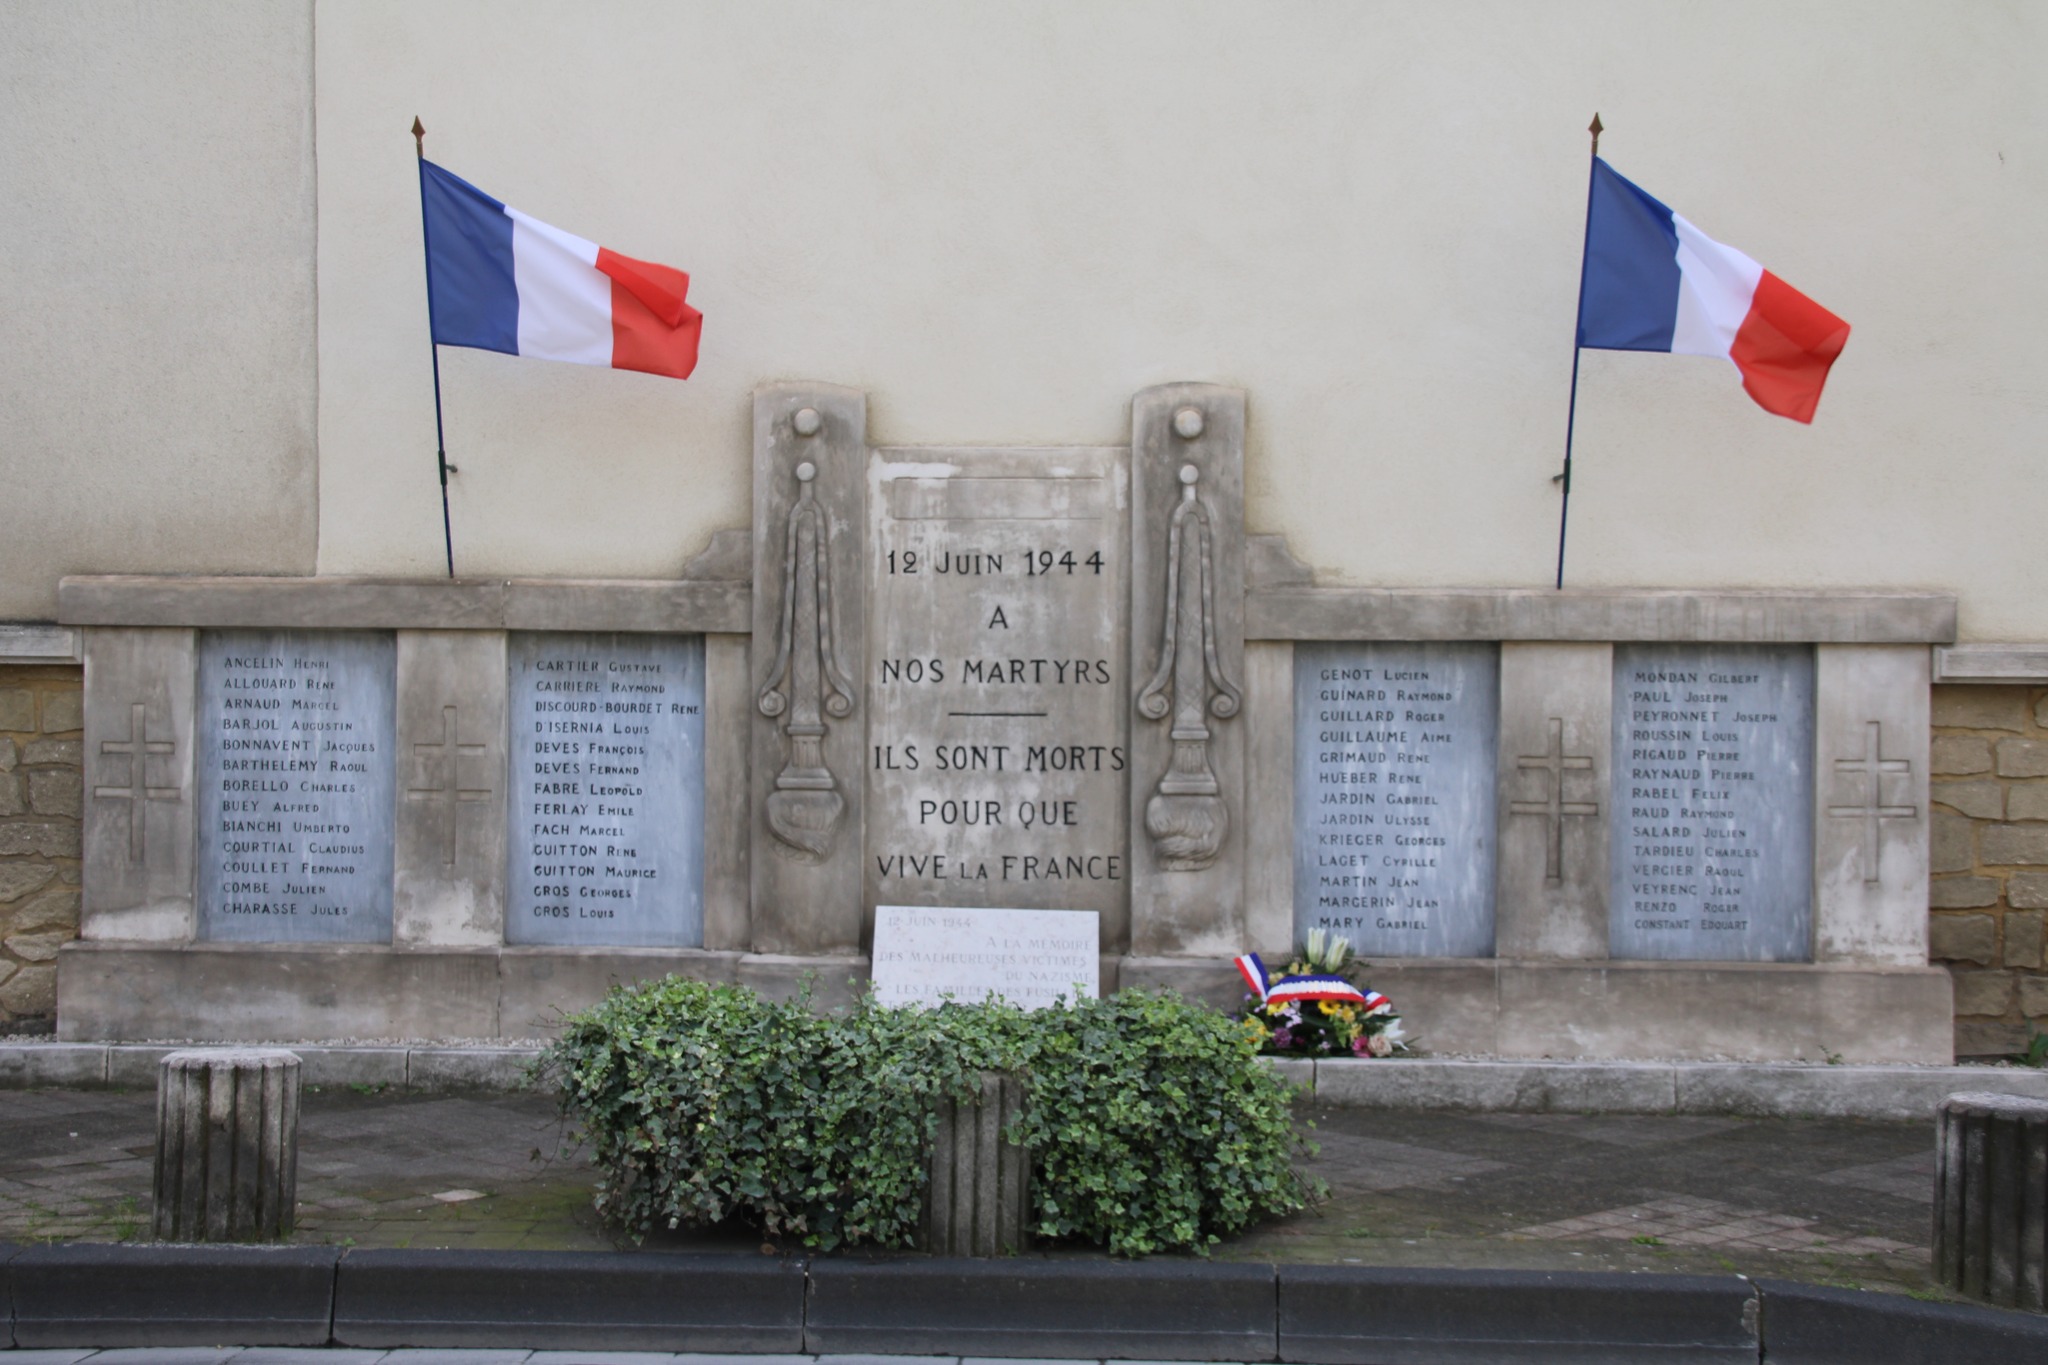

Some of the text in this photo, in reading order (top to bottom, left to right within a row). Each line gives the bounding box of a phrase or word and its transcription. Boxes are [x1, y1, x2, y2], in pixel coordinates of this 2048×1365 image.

[887, 550, 1105, 576] 12 JUIN 1944
[988, 605, 1009, 629] A
[224, 657, 329, 669] ANCELIN HENRI
[536, 660, 662, 674] CARTIER GUSTAVE
[882, 659, 1111, 685] NOS MARTYRS
[1320, 669, 1429, 681] GENOT LUCIEN
[224, 678, 336, 690] ALLOUARD RENE
[536, 681, 665, 694] CARRIERE RAYMOND
[1320, 690, 1452, 702] GUINARD RAYMOND
[224, 699, 340, 711] ARNAUD MARCEL
[671, 703, 700, 715] RENE
[1320, 711, 1445, 723] GUILLARD ROGER
[223, 719, 353, 731] BARJOL AUGUSTIN
[613, 723, 650, 735] LOUIS
[1320, 731, 1452, 743] GUILLAUME AIME
[223, 739, 375, 754] BONNAVENT JACQUES
[535, 742, 579, 754] DEVES
[874, 745, 1125, 772] ILS SONT MORTS
[1320, 752, 1430, 764] GRIMAUD RENE
[223, 760, 368, 772] BARTHELEMY RAOUL
[535, 763, 639, 775] DEVES FERNAND
[1320, 772, 1421, 784] HUEBER RENE
[223, 780, 356, 793] BORELLO CHARLES
[534, 783, 643, 796] FABRE LEOPOLD
[1320, 793, 1439, 805] JARDIN GABRIEL
[222, 801, 319, 813] BUEY ALFRED
[534, 803, 634, 816] FERLAY EMILE
[920, 800, 1078, 829] POUR QUE
[1320, 814, 1430, 826] JARDIN ULYSSE
[222, 821, 350, 834] BIANCHI UMBERTO
[534, 824, 625, 837] FACH MARCEL
[1319, 834, 1446, 846] KRIEGER GEORGES
[223, 842, 365, 855] COURTIAL CLAUDIUS
[533, 844, 637, 858] GUITTON RENE
[223, 862, 355, 874] COULLET FERNAND
[877, 855, 1122, 881] VIVE LA FRANCE
[1318, 855, 1436, 868] LAGET CYRILLE
[534, 865, 657, 878] GUITTON MAURICE
[223, 882, 326, 895] COMBE JULIEN
[1320, 876, 1419, 888] MARTIN JEAN
[534, 886, 632, 899] GROS GEORGES
[223, 903, 348, 916] CHARASSE JULES
[1319, 897, 1439, 909] MARGERIN JEAN
[534, 906, 615, 919] GROS LOUIS
[1319, 917, 1428, 930] MARY GABRIEL
